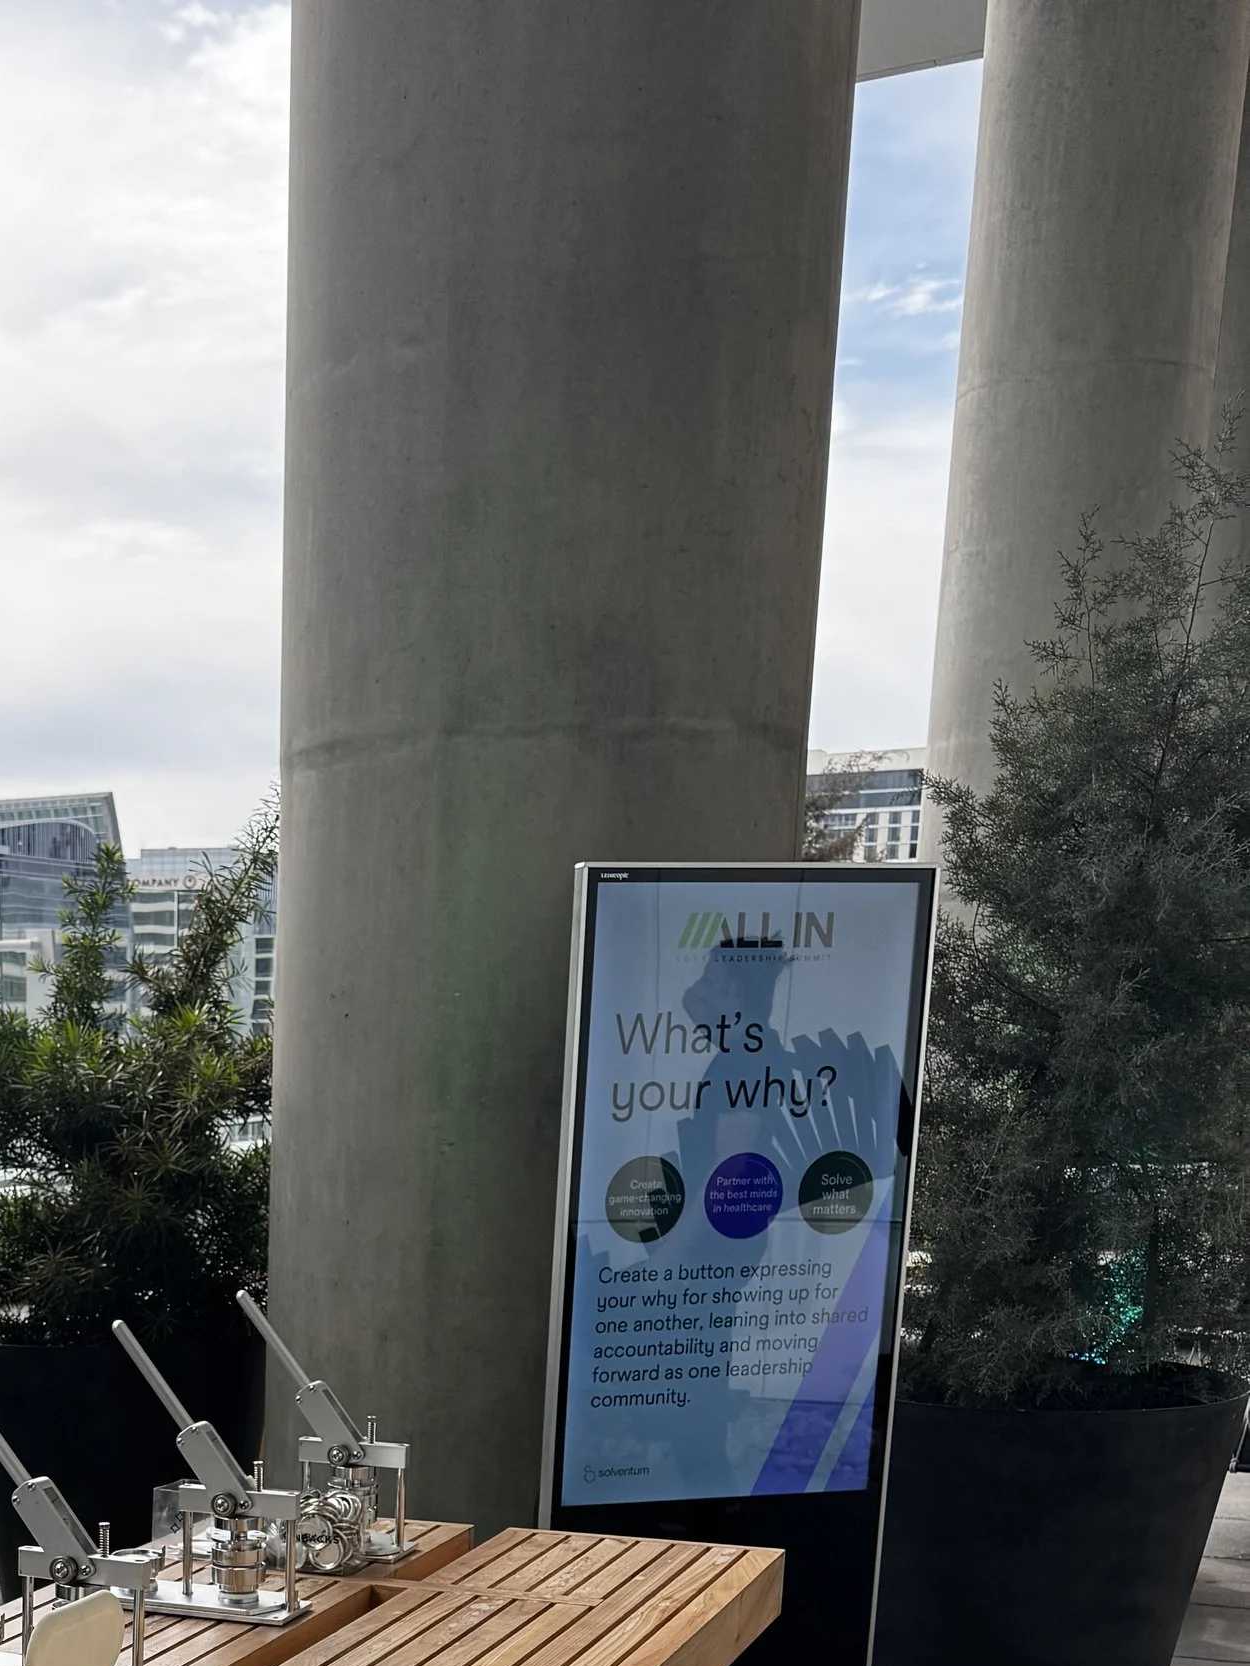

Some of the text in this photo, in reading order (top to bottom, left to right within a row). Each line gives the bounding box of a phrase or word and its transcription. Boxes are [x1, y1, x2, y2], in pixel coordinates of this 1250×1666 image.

[793, 912, 835, 948] IN
[612, 1065, 837, 1123] your why?
[630, 1180, 664, 1191] Create
[716, 1175, 774, 1187] Partner with
[821, 1173, 853, 1185] Solve
[608, 1193, 682, 1206] game-changing
[710, 1188, 778, 1200] the best minds
[822, 1190, 850, 1201] what
[620, 1206, 669, 1217] innovation
[713, 1202, 772, 1213] in healthcare
[813, 1203, 857, 1216] matters
[598, 1259, 832, 1284] Create a button expressing
[596, 1283, 839, 1312] your why for showing up for
[595, 1306, 869, 1334] one another, leaning into shared
[593, 1333, 818, 1359] accountability and moving
[593, 1358, 813, 1384] forward as one leadership
[590, 1388, 691, 1408] community.
[598, 1466, 650, 1478] solventum
